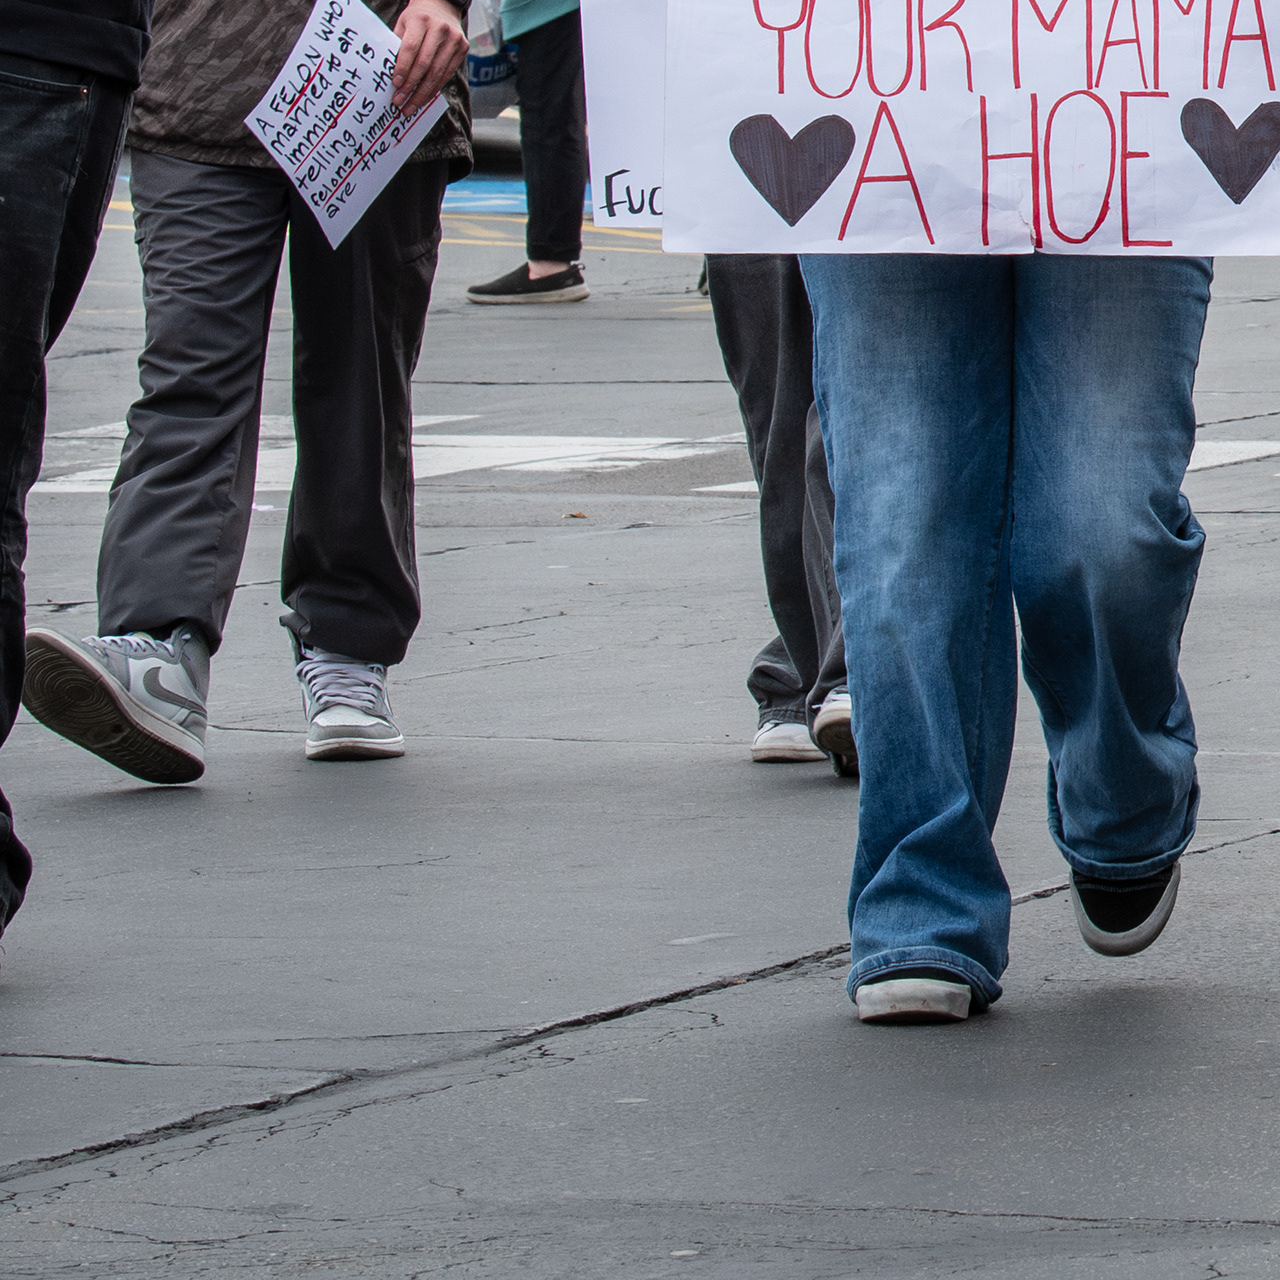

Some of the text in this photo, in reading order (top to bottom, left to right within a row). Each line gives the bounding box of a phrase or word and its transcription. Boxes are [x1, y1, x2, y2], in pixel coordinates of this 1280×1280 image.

[255, 117, 275, 137] A
[269, 44, 323, 114] FELON
[270, 27, 358, 156] married to an
[284, 42, 375, 166] immigrant is
[295, 129, 357, 190] telling
[352, 96, 375, 124] us
[310, 156, 354, 207] felons
[326, 181, 357, 219] are
[361, 140, 391, 172] the
[839, 90, 1173, 249] A HOE
